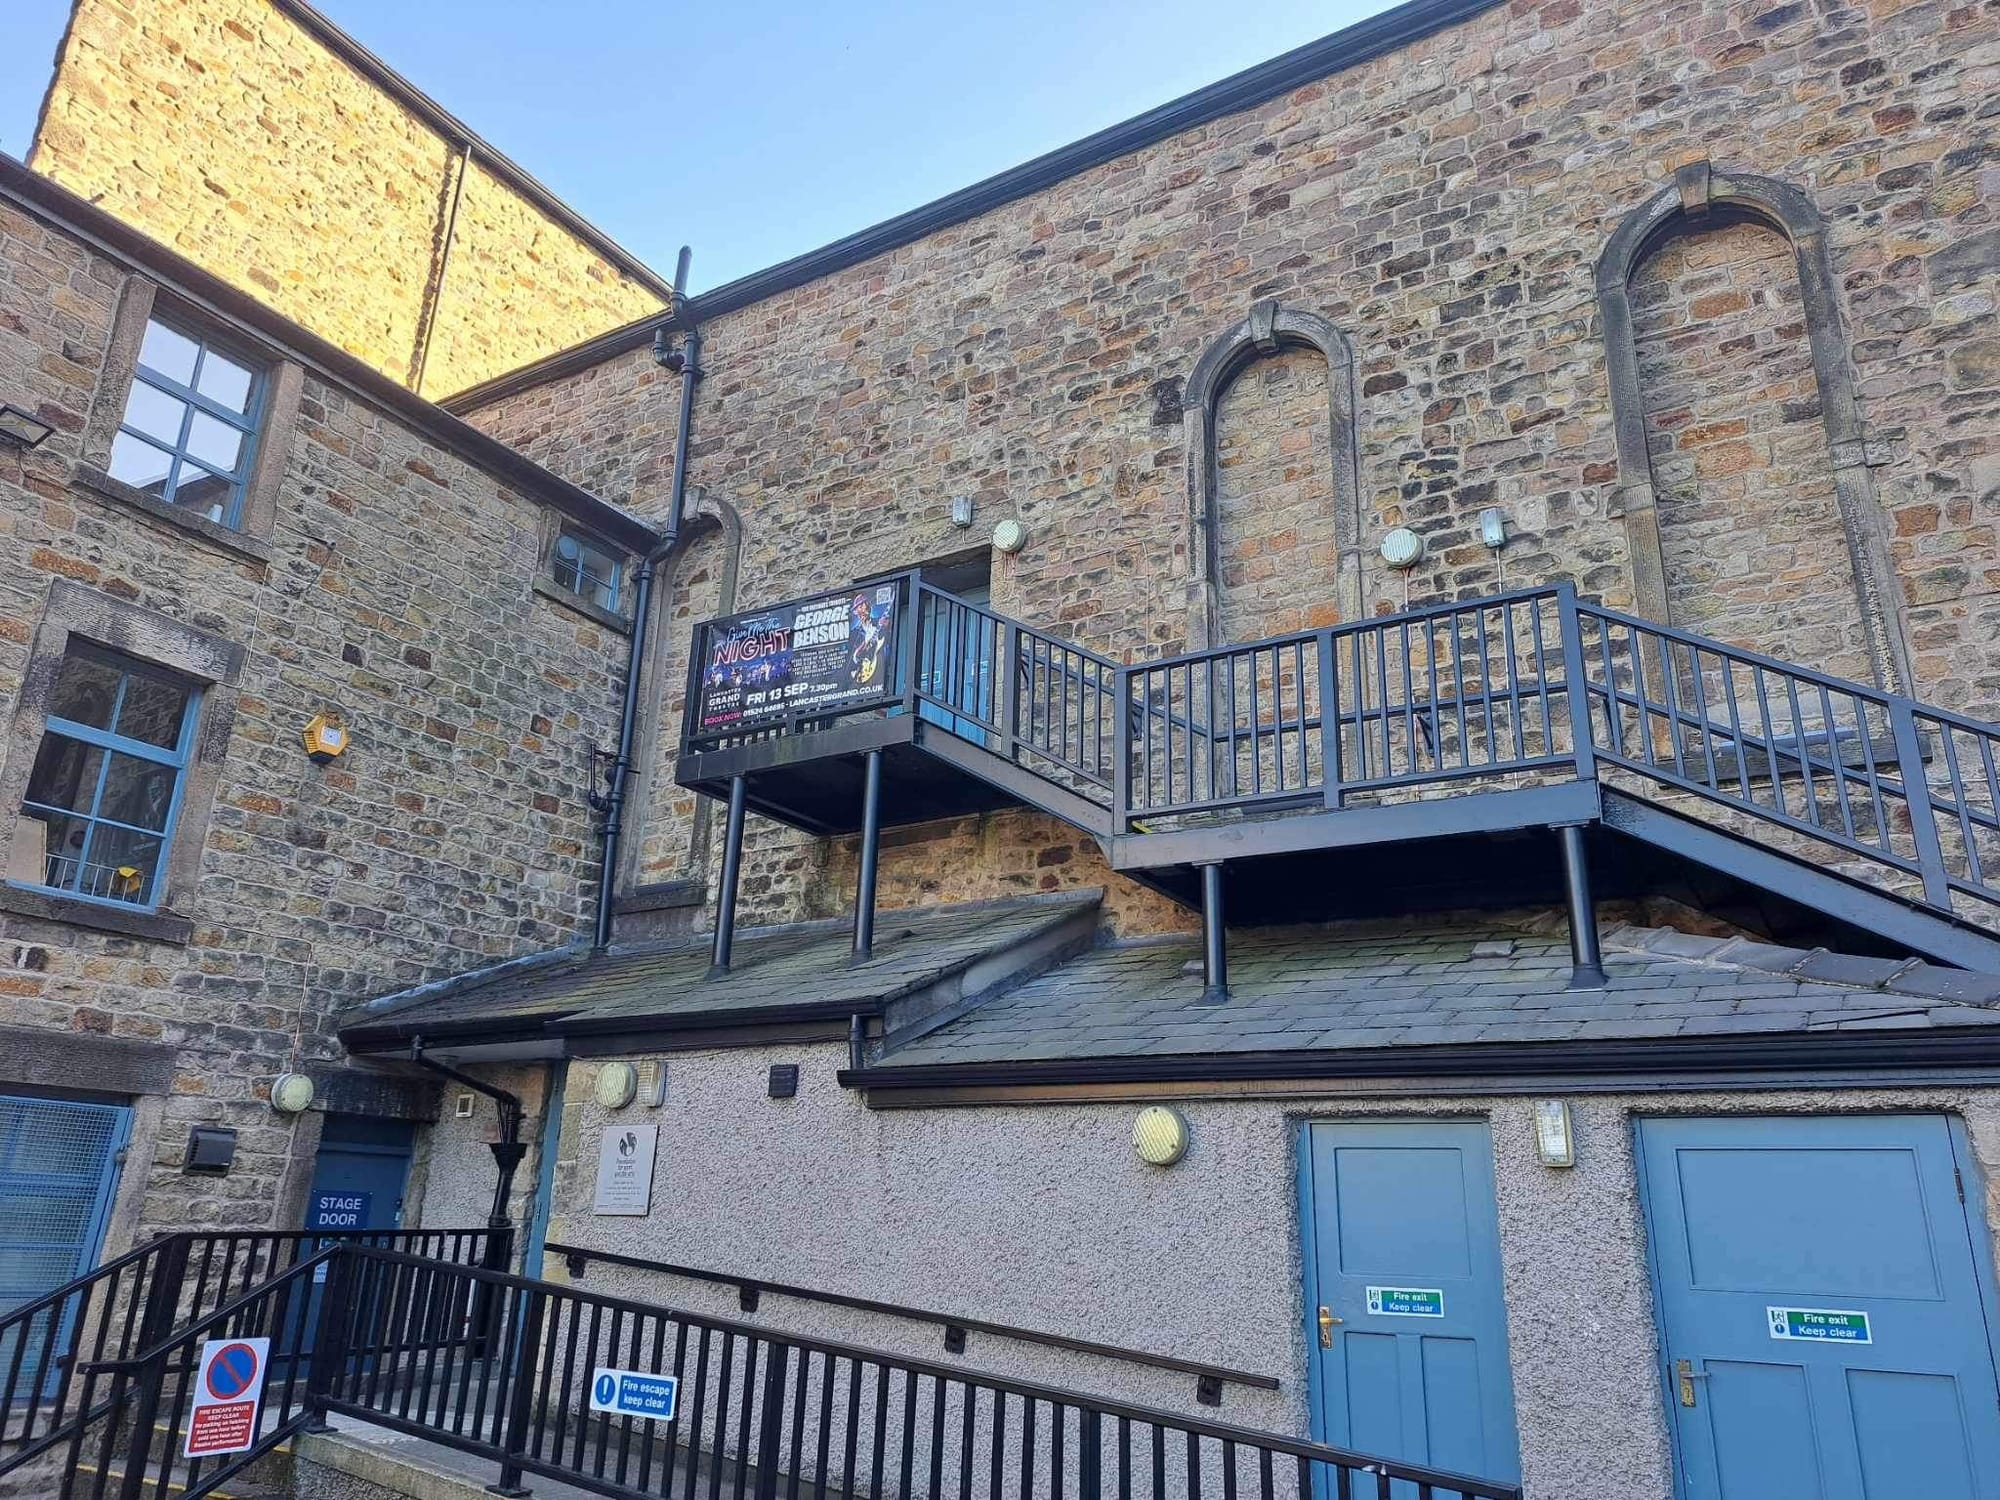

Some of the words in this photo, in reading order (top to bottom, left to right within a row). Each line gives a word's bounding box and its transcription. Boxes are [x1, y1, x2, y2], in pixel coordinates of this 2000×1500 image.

[794, 604, 850, 630] GEORGE
[727, 626, 748, 644] Give
[793, 621, 850, 648] BENSON
[713, 627, 791, 666] NIGHT
[709, 693, 741, 706] GRAND
[746, 690, 767, 706] FRI
[768, 687, 783, 701] 13
[783, 682, 809, 697] SEP
[809, 683, 838, 693] 7.30pm
[704, 714, 723, 726] BOOK
[789, 684, 884, 708] LANCASTERGRAND.CO.UK
[319, 1197, 363, 1209] STAGE
[318, 1213, 357, 1225] DOOR
[1393, 1291, 1410, 1300] Fire
[1412, 1293, 1427, 1301] exit
[1389, 1302, 1409, 1312] Keep
[1412, 1303, 1433, 1312] clear
[1803, 1313, 1825, 1324] Fire
[1828, 1315, 1848, 1325] exit
[1798, 1325, 1827, 1337] Keep
[1829, 1327, 1857, 1337] clear
[623, 1379, 639, 1391] Fire
[640, 1383, 670, 1397] escape
[623, 1394, 643, 1407] keep
[645, 1396, 666, 1408] clear
